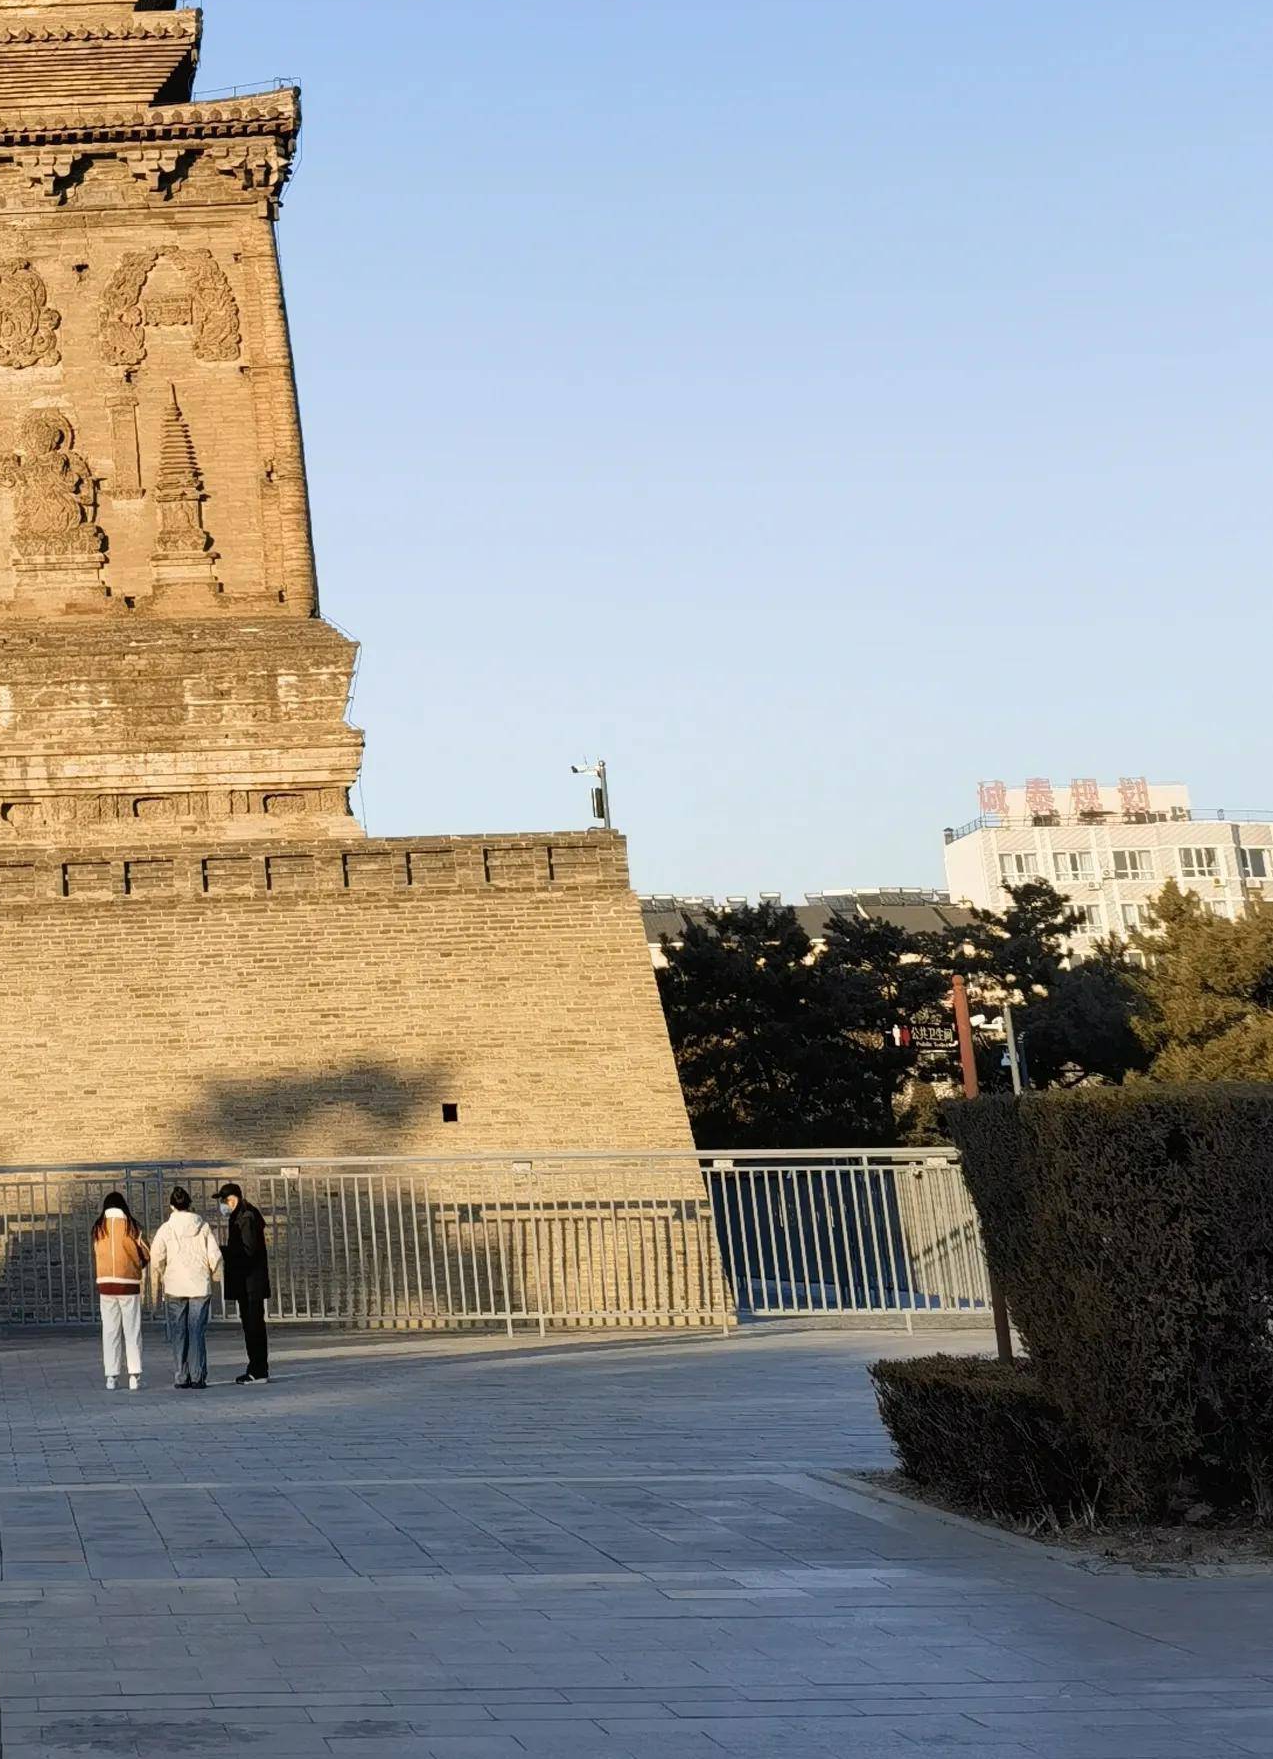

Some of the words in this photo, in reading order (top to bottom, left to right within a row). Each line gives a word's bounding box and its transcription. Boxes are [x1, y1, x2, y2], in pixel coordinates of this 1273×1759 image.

[912, 1026, 953, 1042] 公共卫生间
